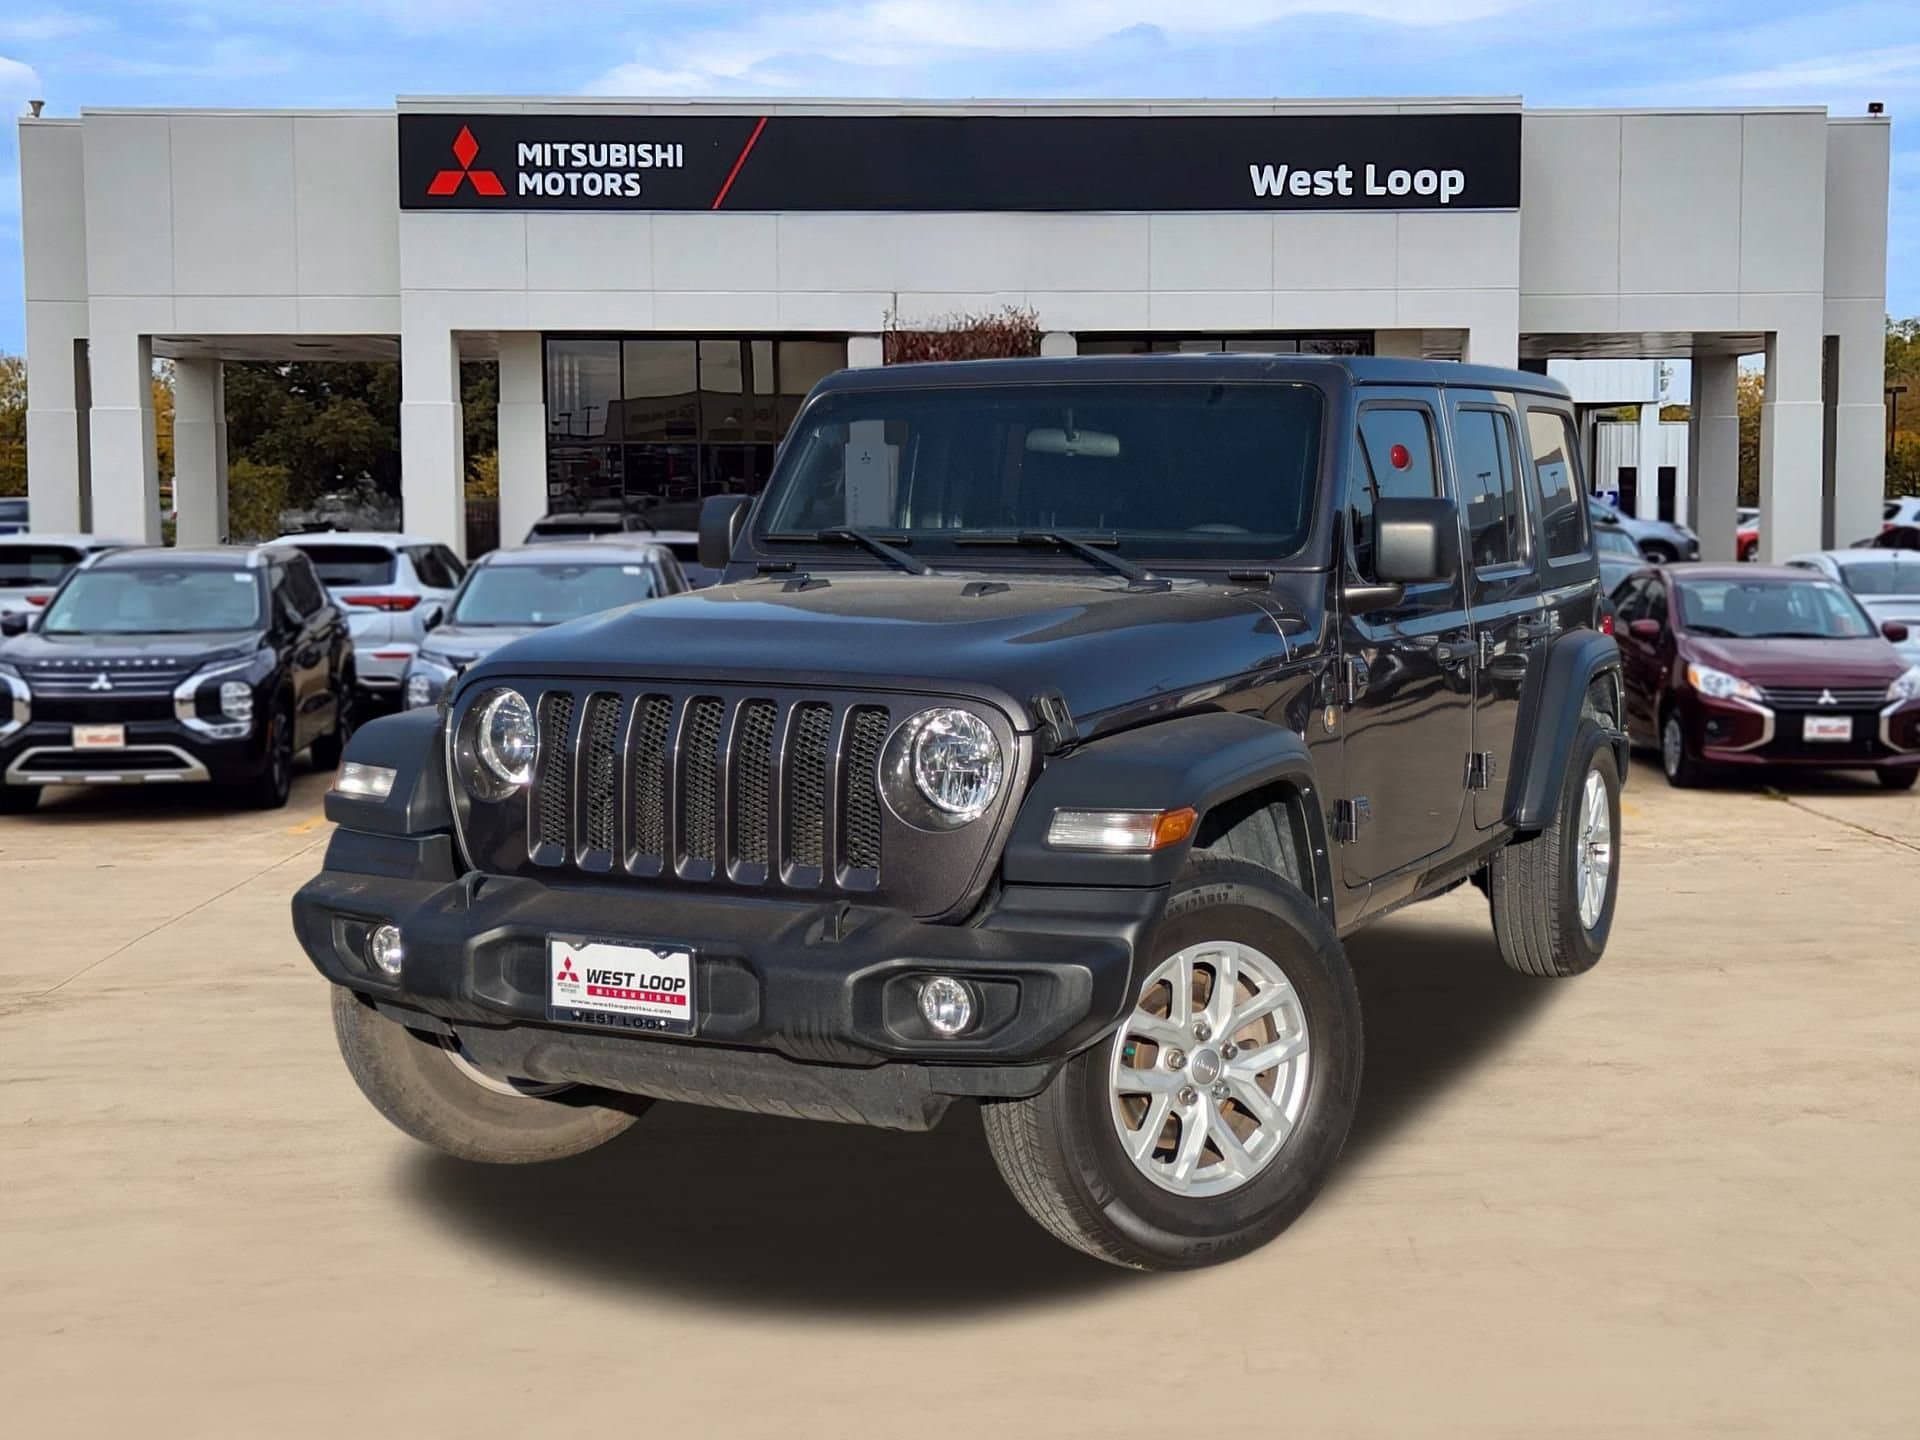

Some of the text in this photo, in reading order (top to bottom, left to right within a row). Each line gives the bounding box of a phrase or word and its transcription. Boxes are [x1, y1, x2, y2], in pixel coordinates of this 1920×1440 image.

[518, 143, 684, 168] MITSUBISHI
[518, 172, 641, 197] MOTORS
[1250, 164, 1465, 203] West Loop
[586, 968, 635, 987] WEST
[639, 974, 686, 992] LOOP
[595, 987, 679, 1004] MITSUBISHI
[570, 1009, 669, 1031] WEST LOOP
